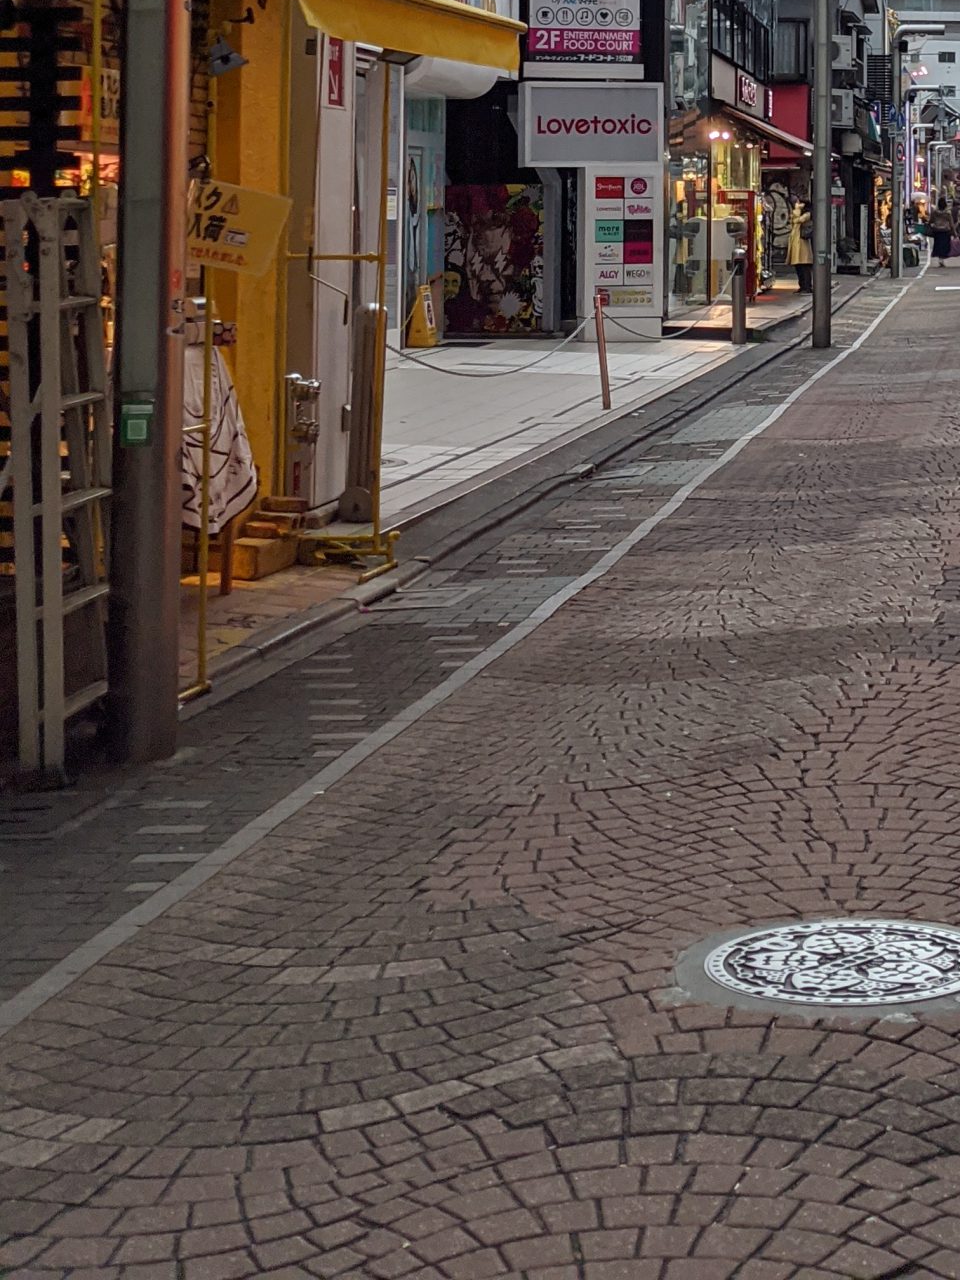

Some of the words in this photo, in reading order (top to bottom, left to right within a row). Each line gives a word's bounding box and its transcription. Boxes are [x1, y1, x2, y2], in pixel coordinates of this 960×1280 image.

[535, 30, 561, 50] 2F
[563, 31, 634, 41] ENTERTAINMENT
[563, 40, 595, 50] FOOD
[597, 41, 634, 51] COURT
[626, 269, 646, 278] WEGO
